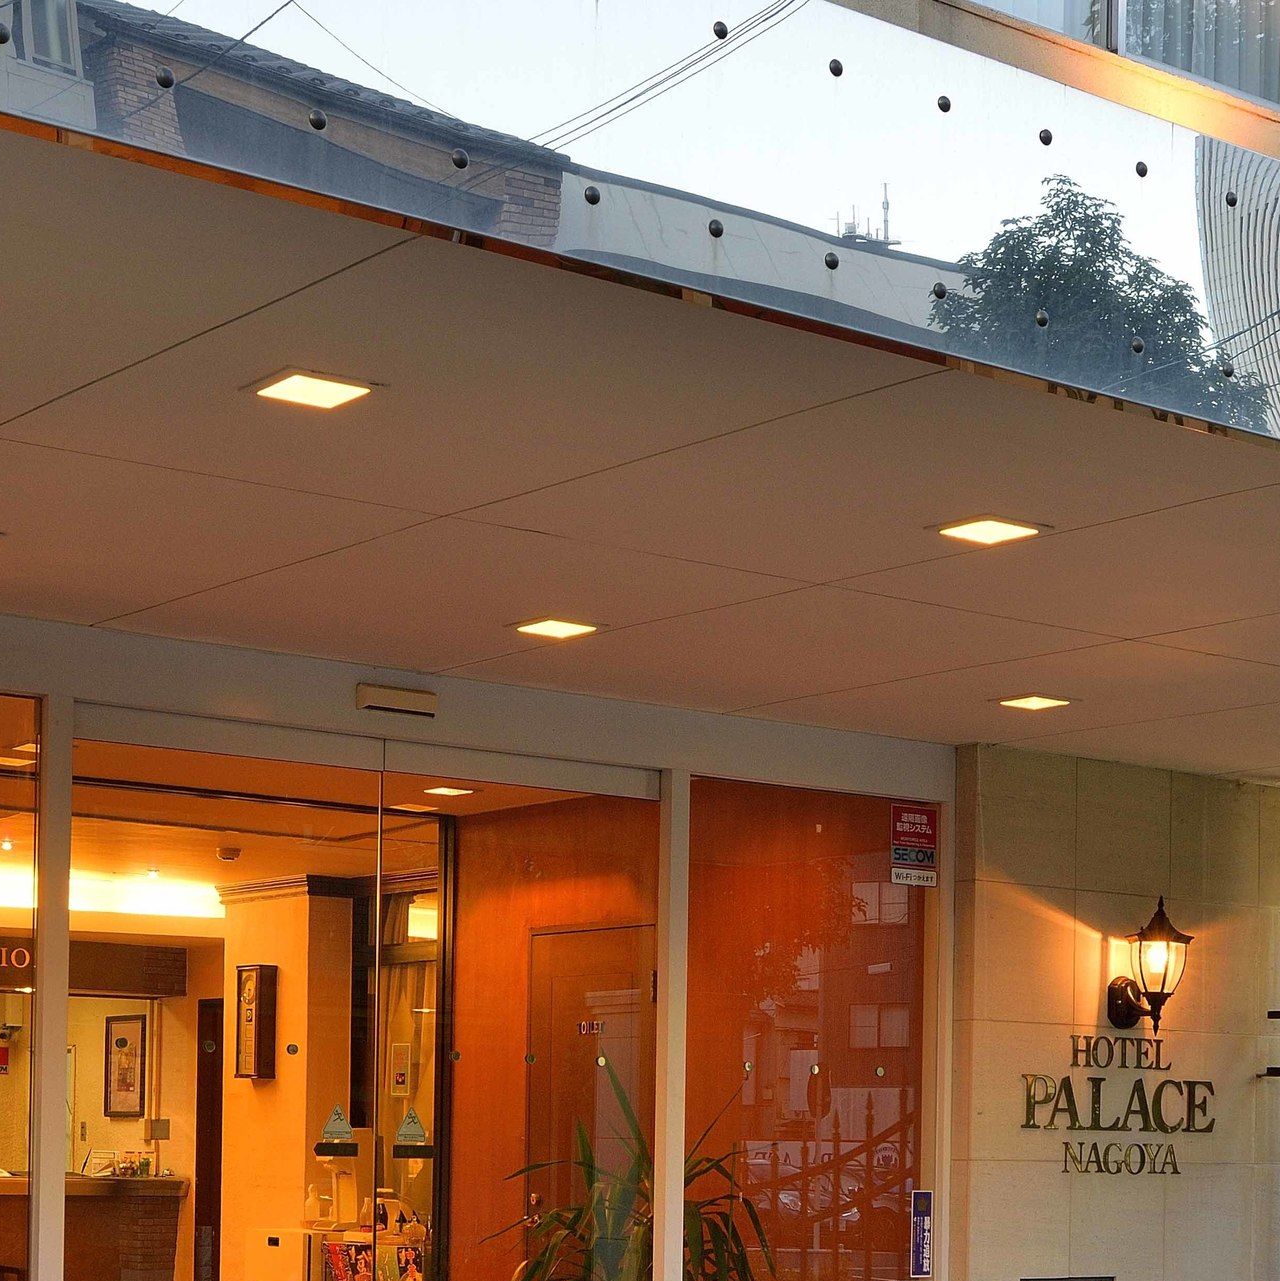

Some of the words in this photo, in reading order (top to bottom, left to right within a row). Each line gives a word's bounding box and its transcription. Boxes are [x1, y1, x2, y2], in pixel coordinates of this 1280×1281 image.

[894, 849, 934, 864] SECOM
[1070, 1035, 1172, 1071] HOTEL
[1020, 1074, 1216, 1133] PALACE
[1061, 1142, 1181, 1175] NAGOYA
